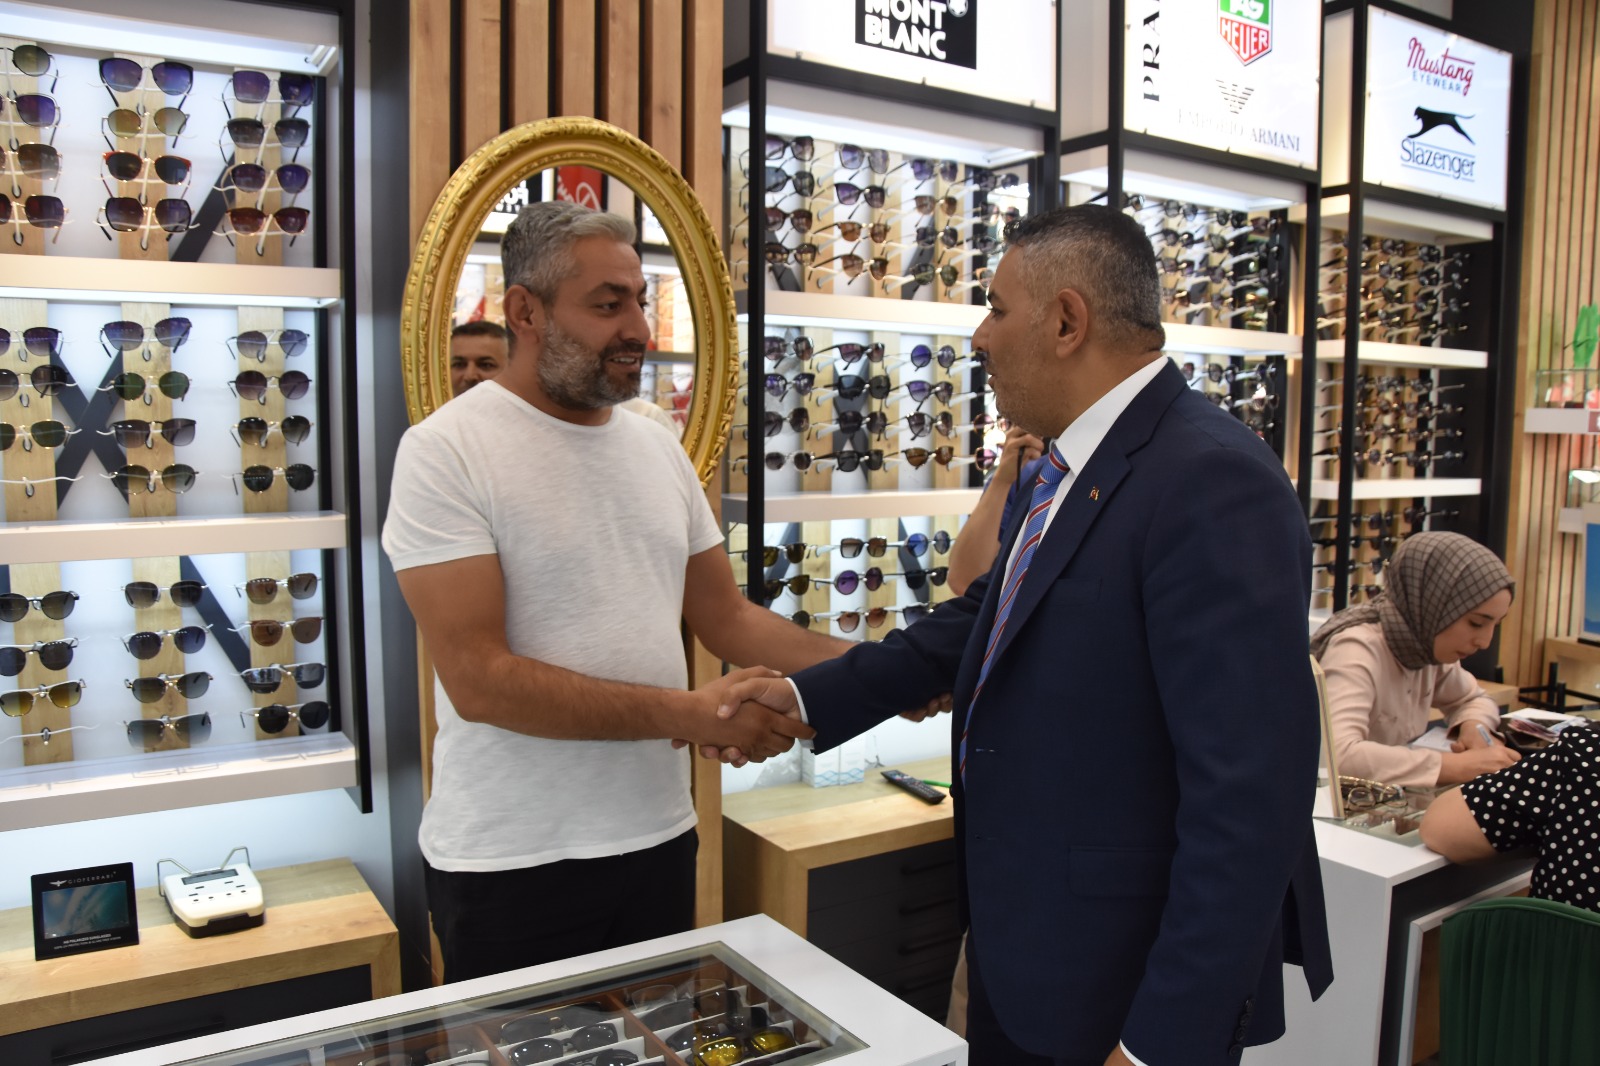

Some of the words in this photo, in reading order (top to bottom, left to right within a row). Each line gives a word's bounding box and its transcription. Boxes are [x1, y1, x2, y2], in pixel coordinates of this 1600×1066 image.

[865, 13, 947, 60] BLANC
[1143, 0, 1160, 101] PRA
[1221, 18, 1268, 60] HEUER
[1407, 37, 1475, 96] Mustang
[1412, 69, 1461, 93] EYEWEAR
[1250, 127, 1300, 152] ARMANI
[1401, 138, 1476, 180] Slazenger
